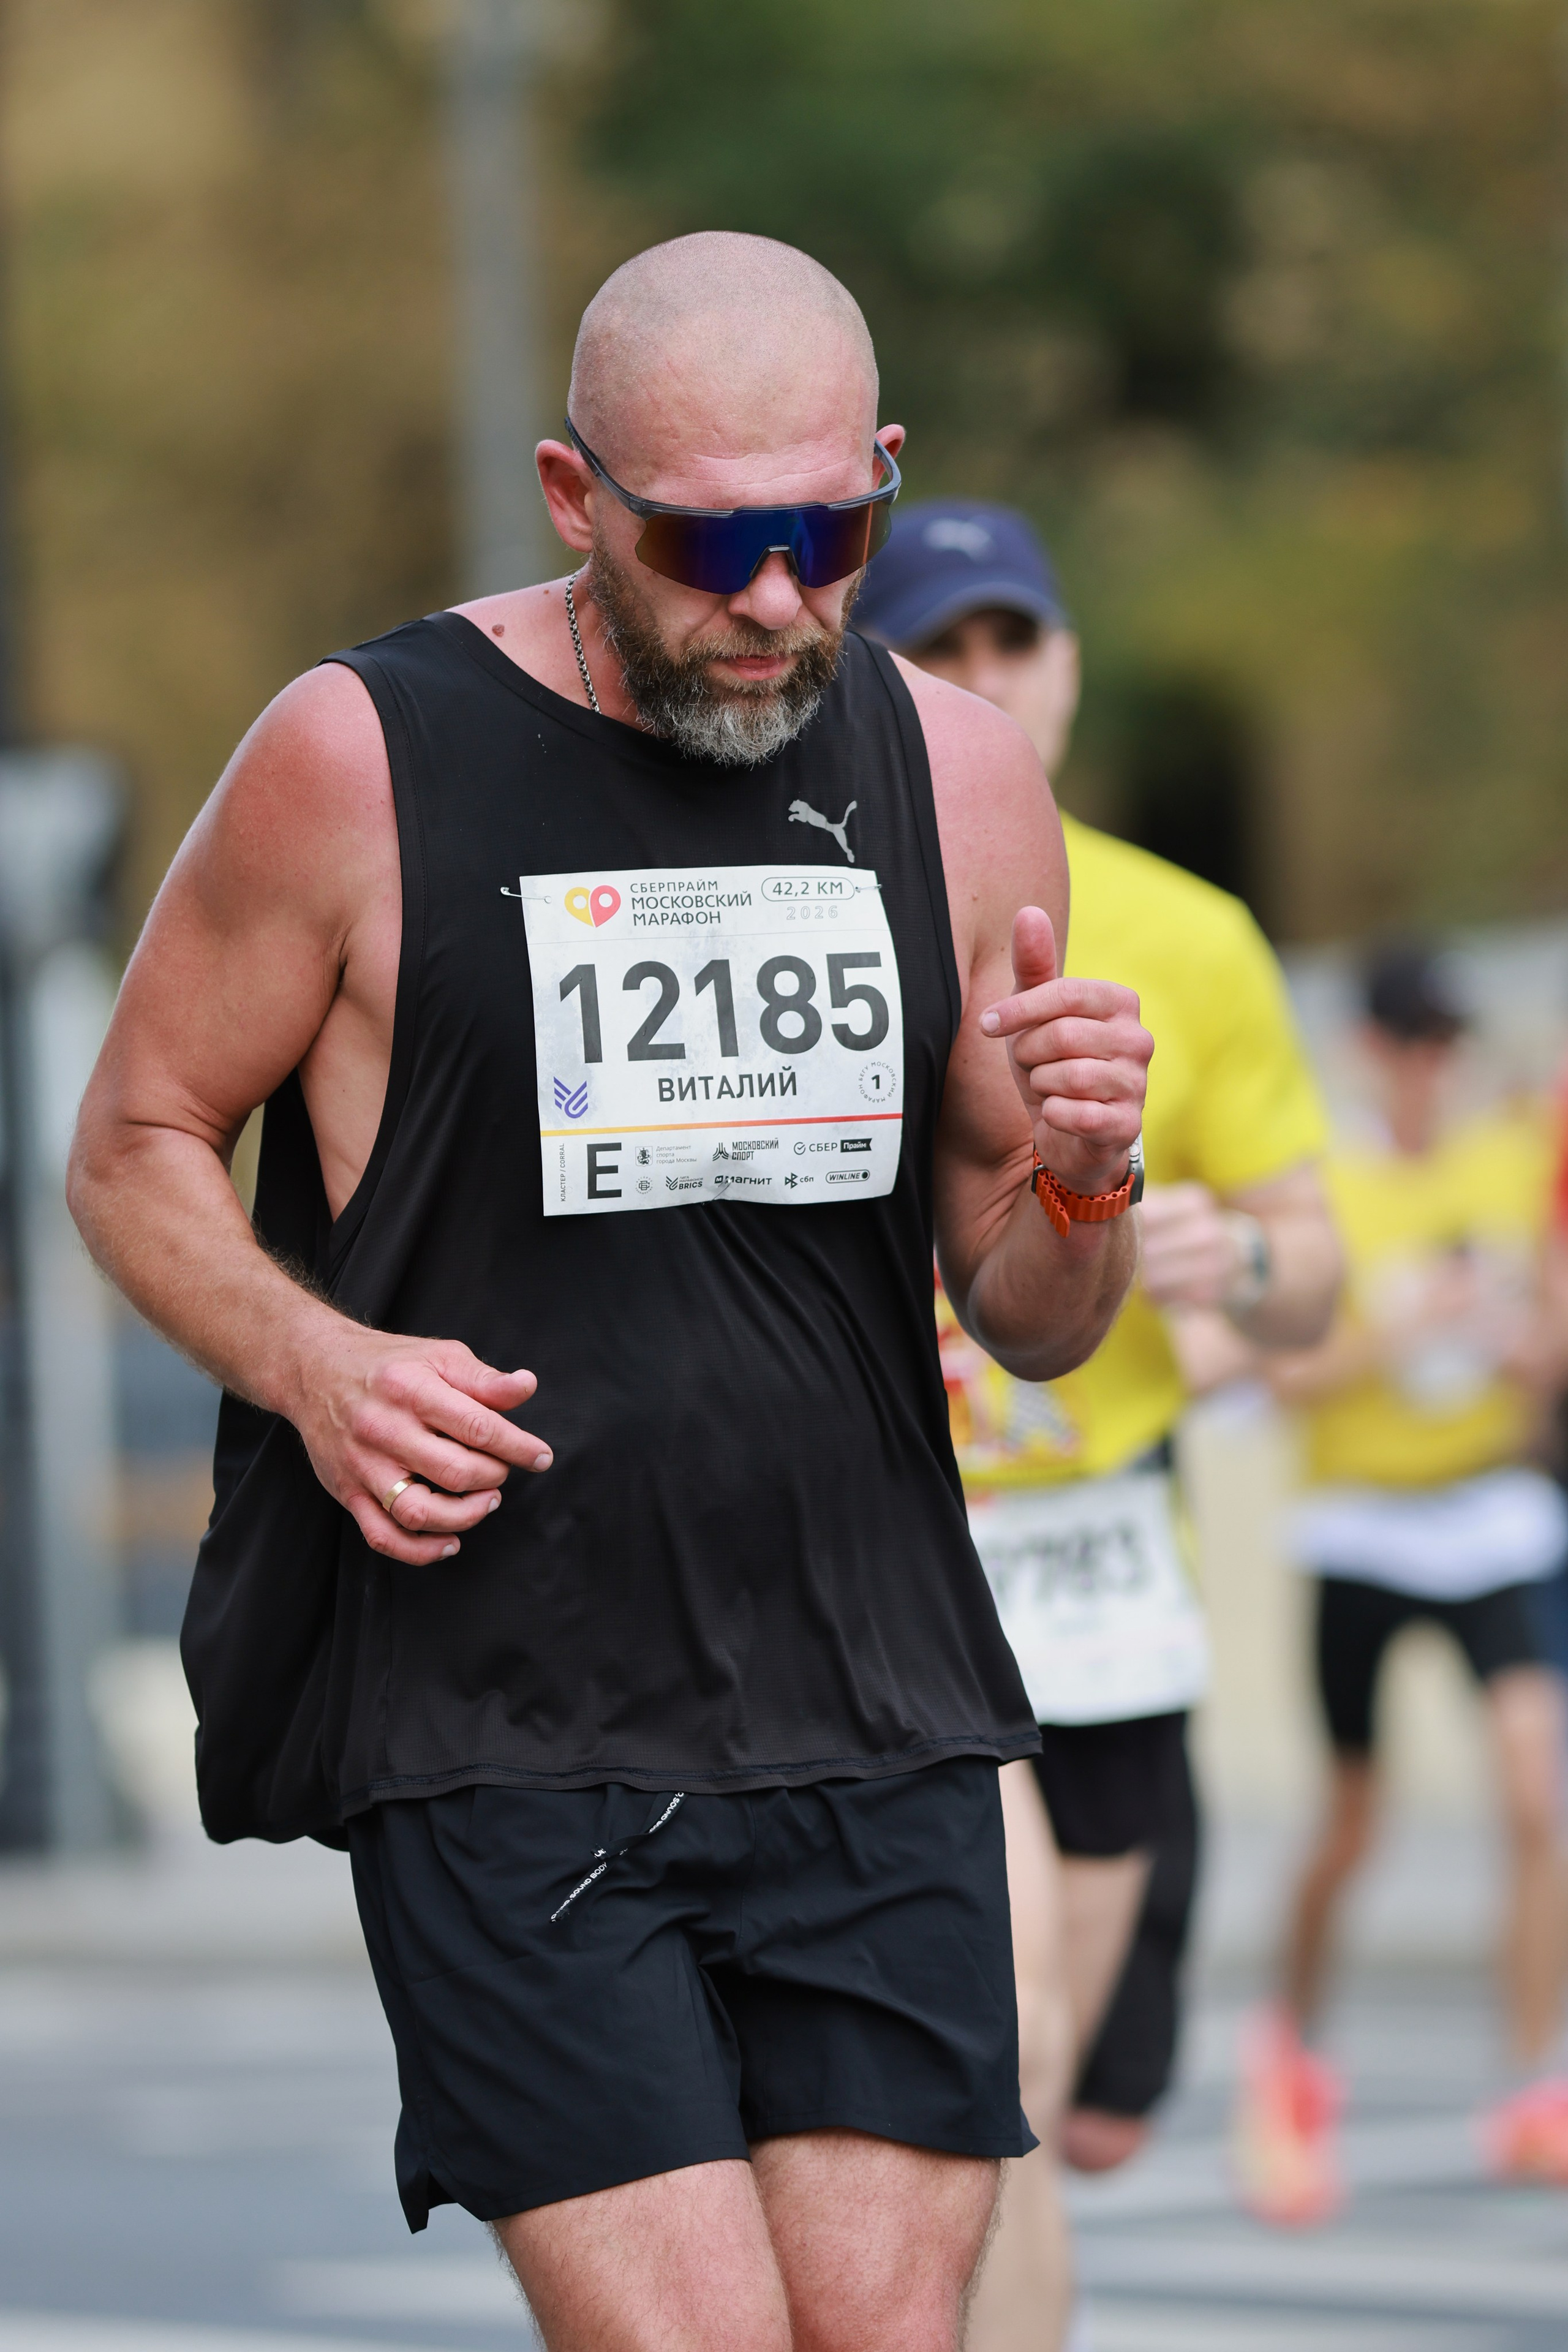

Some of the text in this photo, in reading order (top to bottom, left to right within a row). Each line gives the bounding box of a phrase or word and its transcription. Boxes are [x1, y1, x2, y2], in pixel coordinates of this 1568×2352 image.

[630, 879, 718, 893] СБЕРПРАЙМ
[772, 881, 843, 897] 42,2 КМ
[631, 891, 752, 910] МОСКОВСКИЙ
[633, 911, 722, 926] МАРАФОН
[786, 905, 838, 920] 2026
[559, 952, 889, 1064] 12185
[658, 1066, 797, 1102] ВИТАЛИЙ
[871, 1074, 880, 1090] 1
[732, 1137, 779, 1151] МОСКОВСКИЙ
[809, 1141, 867, 1152] СБЕР Прайм
[732, 1151, 754, 1161] СПОРТ
[679, 1181, 703, 1189] BRICS
[829, 1173, 861, 1182] WINLINE
[590, 1862, 608, 1879] BODY
